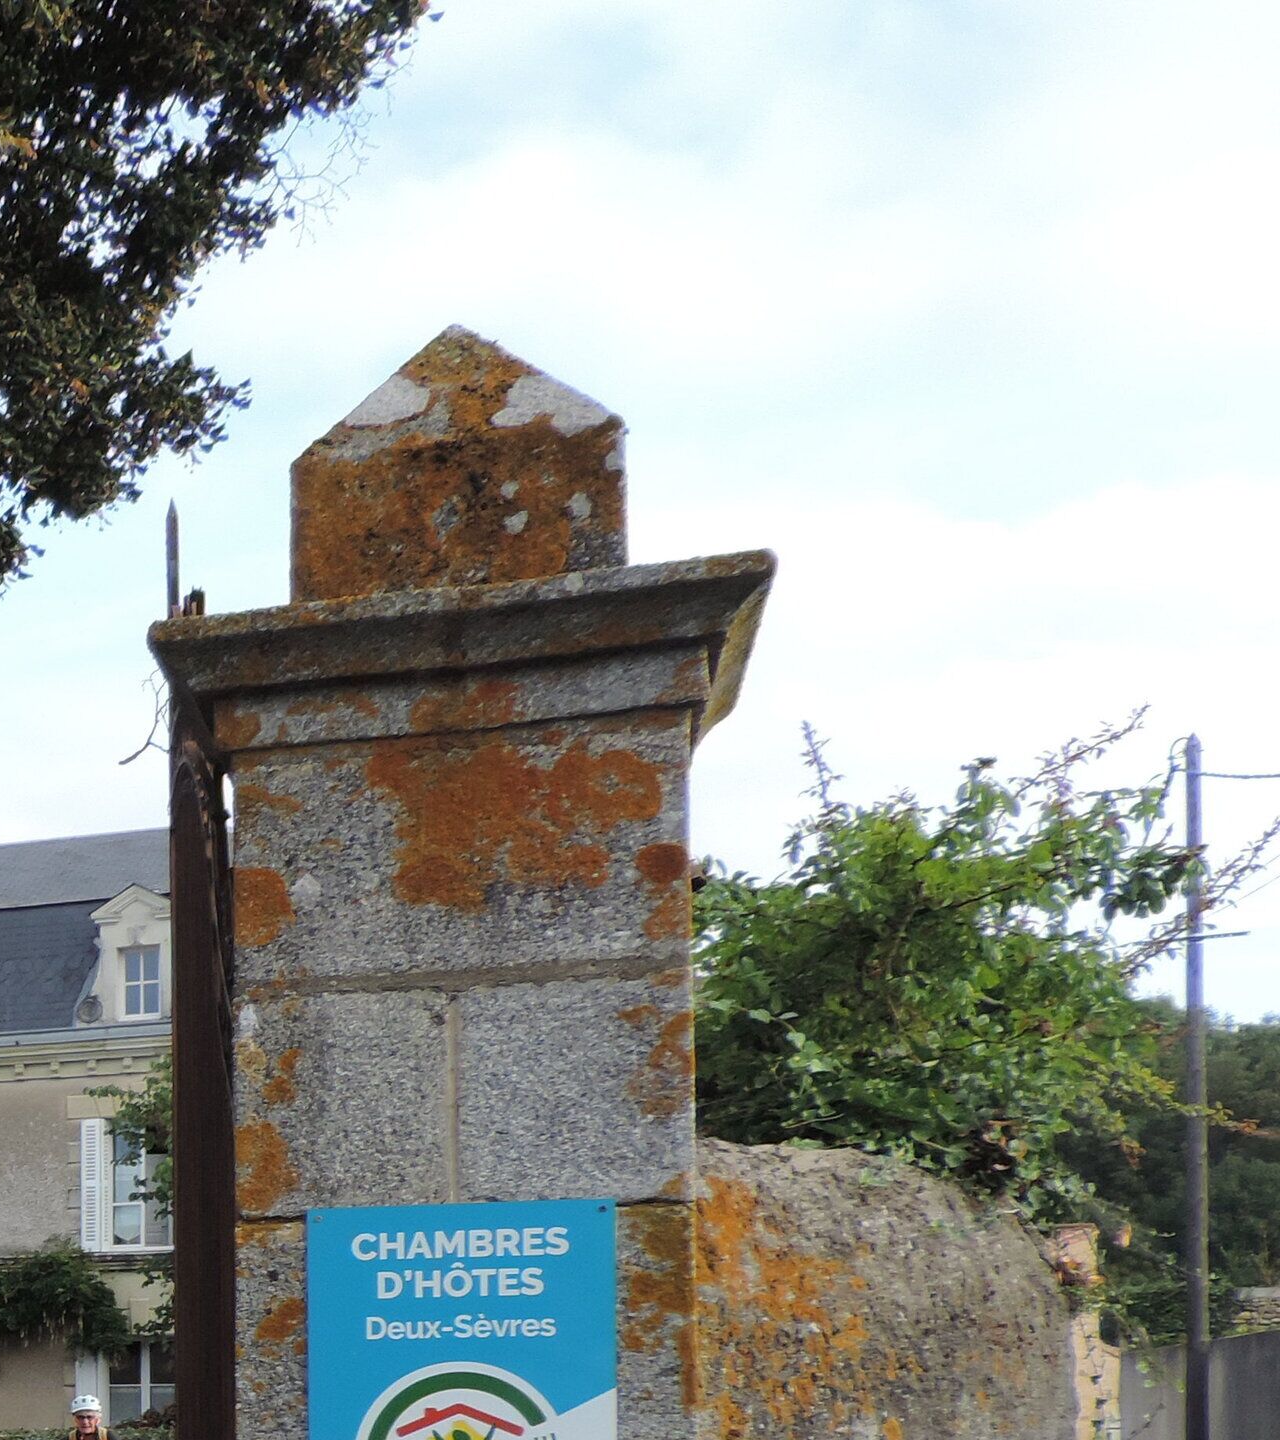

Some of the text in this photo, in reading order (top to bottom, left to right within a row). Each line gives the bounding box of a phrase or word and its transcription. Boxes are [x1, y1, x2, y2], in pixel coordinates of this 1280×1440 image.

[351, 1226, 570, 1261] CHAMBRES
[376, 1262, 545, 1299] D'HÔTES
[365, 1313, 557, 1340] Deux-Sèvres
